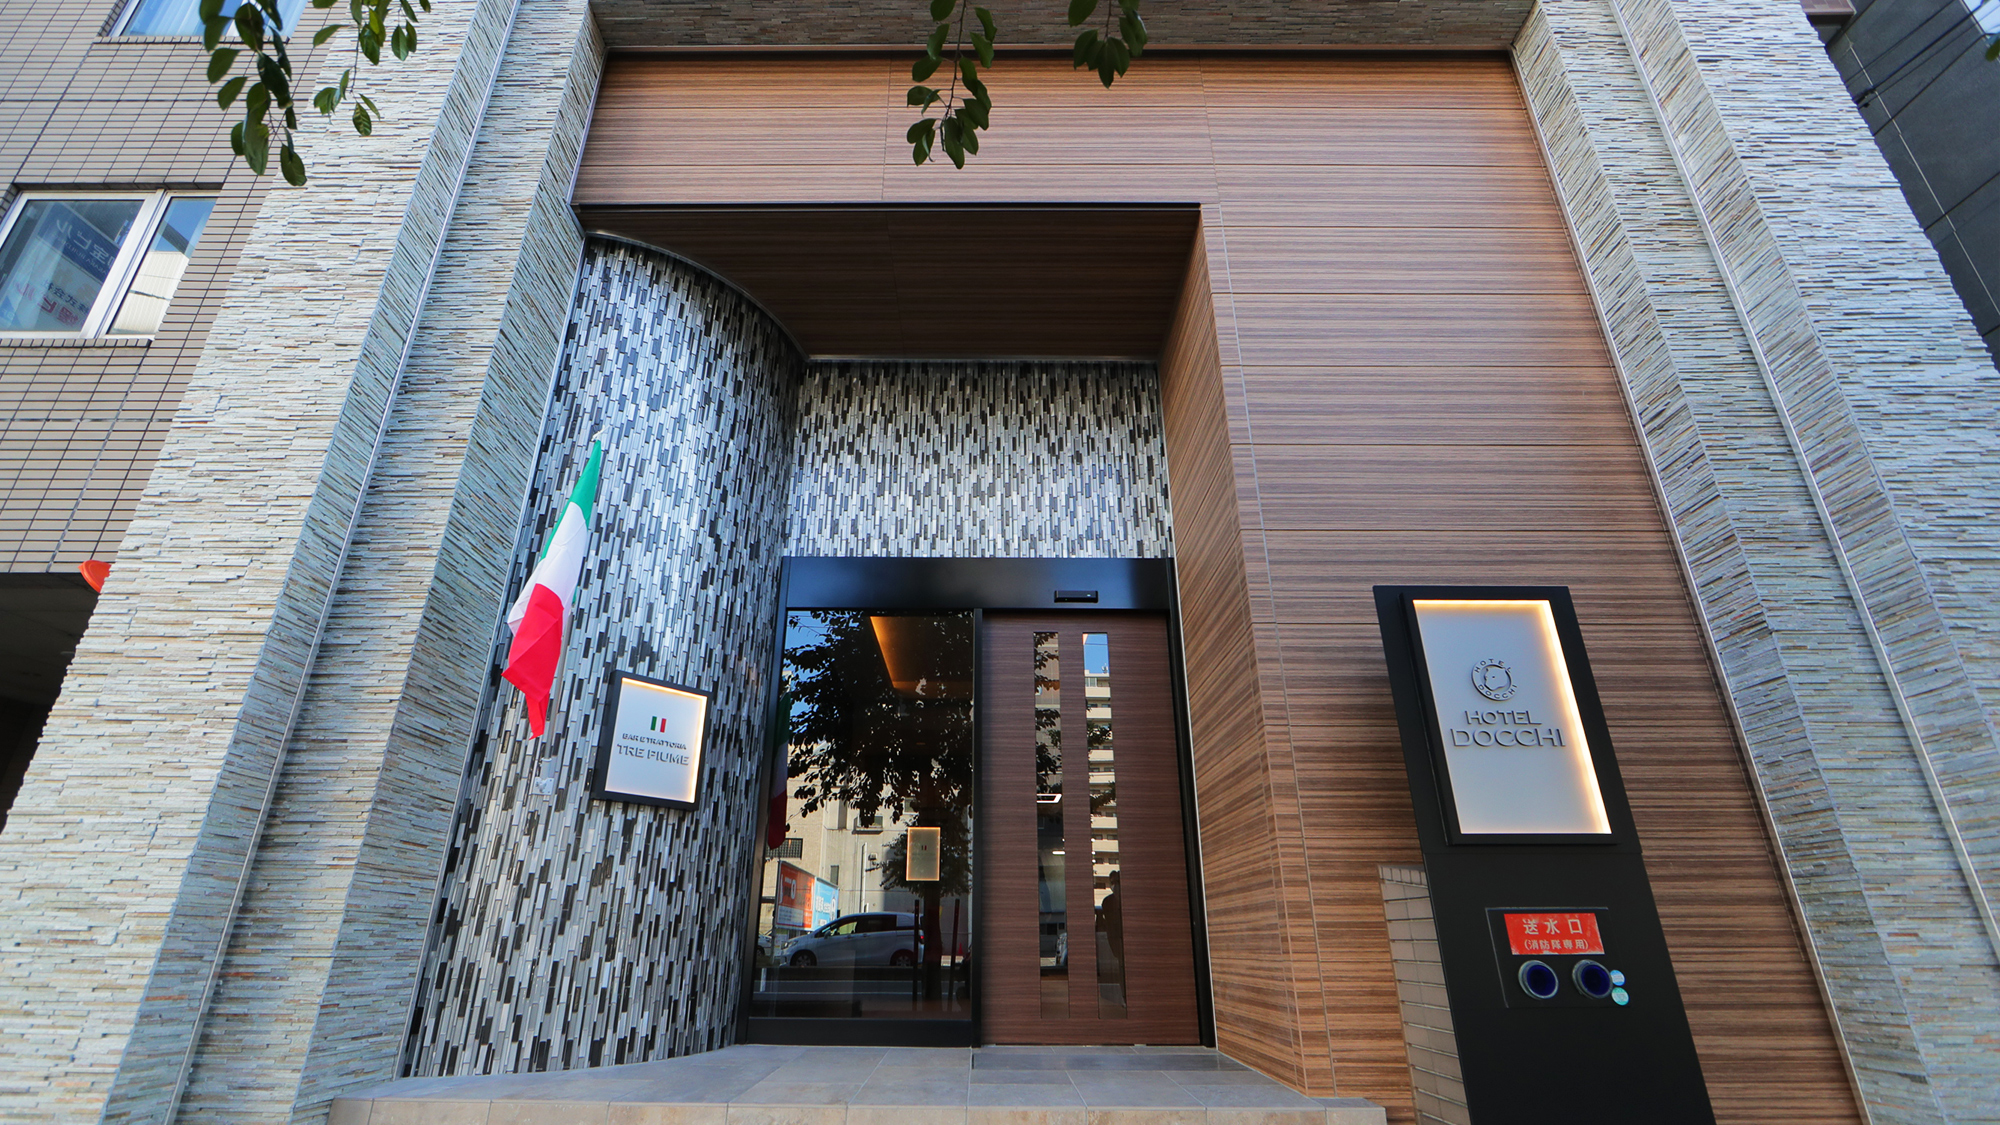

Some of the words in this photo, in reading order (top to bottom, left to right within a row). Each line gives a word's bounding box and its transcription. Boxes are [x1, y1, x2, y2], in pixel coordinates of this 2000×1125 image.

[1474, 658, 1511, 673] HOTEL
[1478, 684, 1518, 699] DOCCHI
[1464, 710, 1542, 725] HOTEL
[622, 733, 639, 742] BAR
[646, 737, 687, 750] TRATTORIA
[1450, 728, 1566, 747] DOCCHI
[617, 743, 645, 758] TRE
[1522, 918, 1584, 935] 送水口
